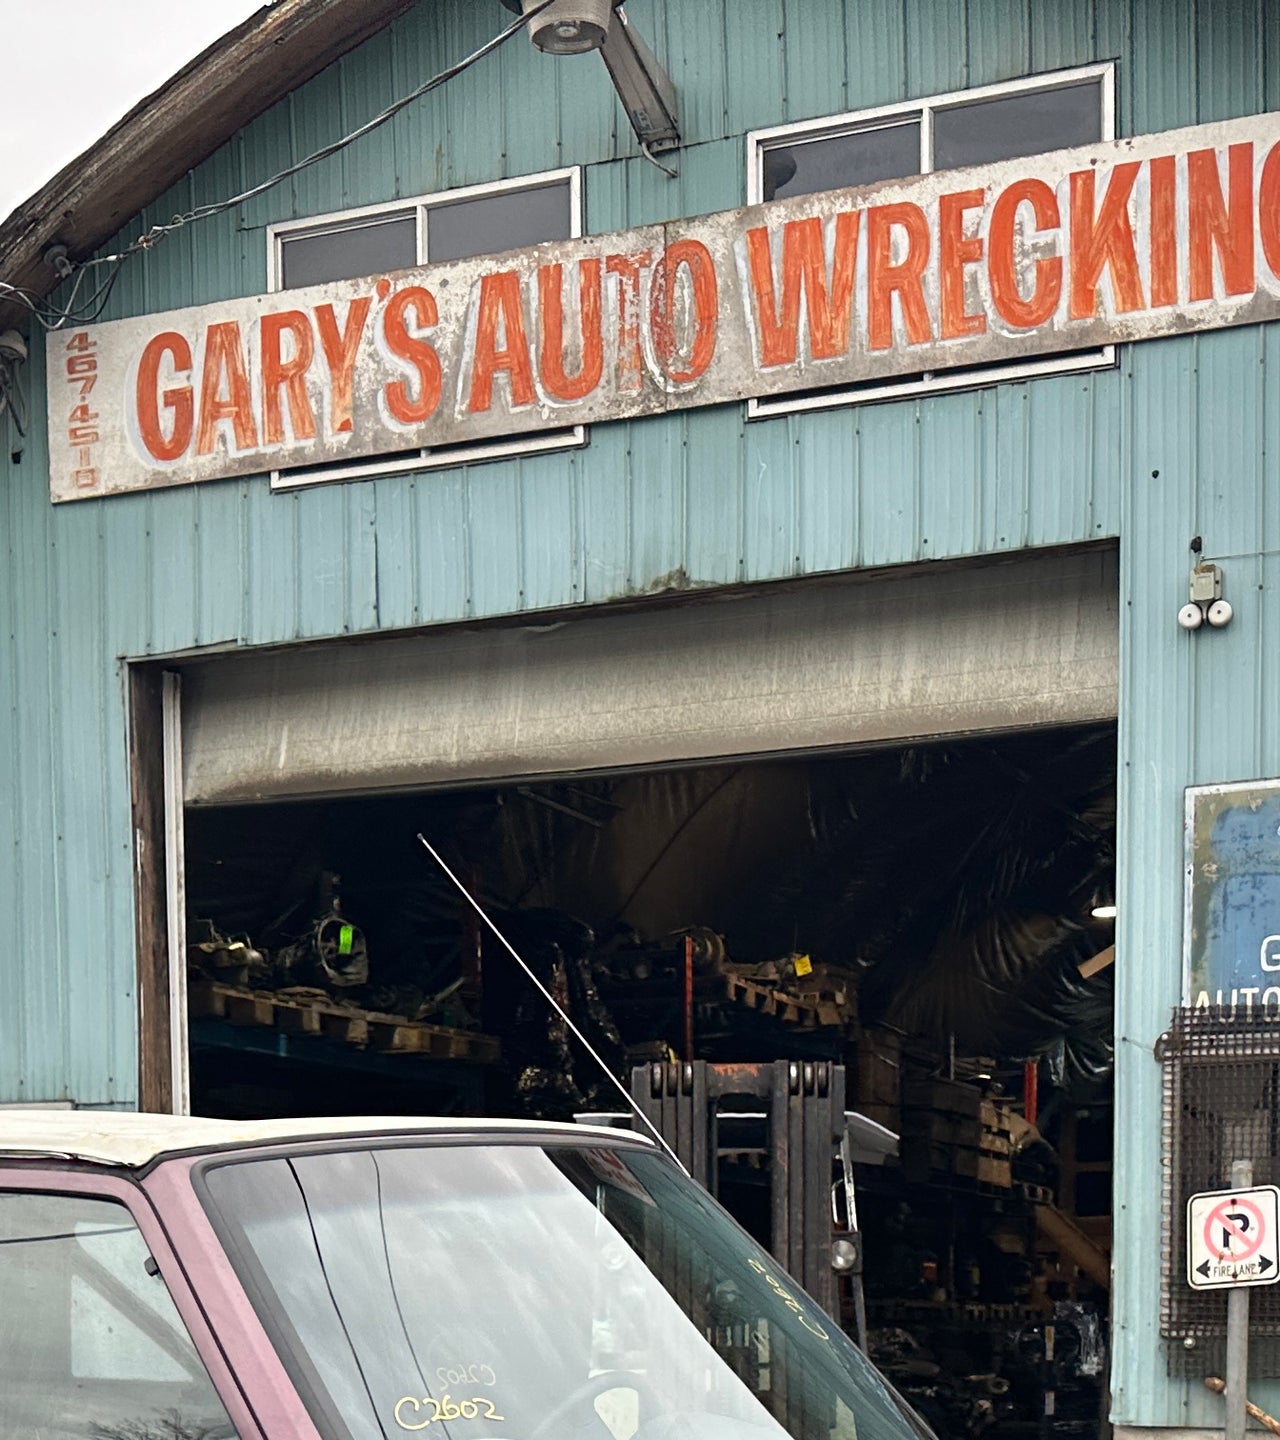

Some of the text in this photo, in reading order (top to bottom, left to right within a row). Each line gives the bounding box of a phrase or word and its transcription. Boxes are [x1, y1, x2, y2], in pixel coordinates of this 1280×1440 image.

[134, 277, 443, 462] GARY'S
[467, 238, 720, 413] AUTO
[747, 1258, 830, 1340] C2602
[1213, 1266, 1232, 1278] FIRE
[394, 1394, 505, 1430] C2602
